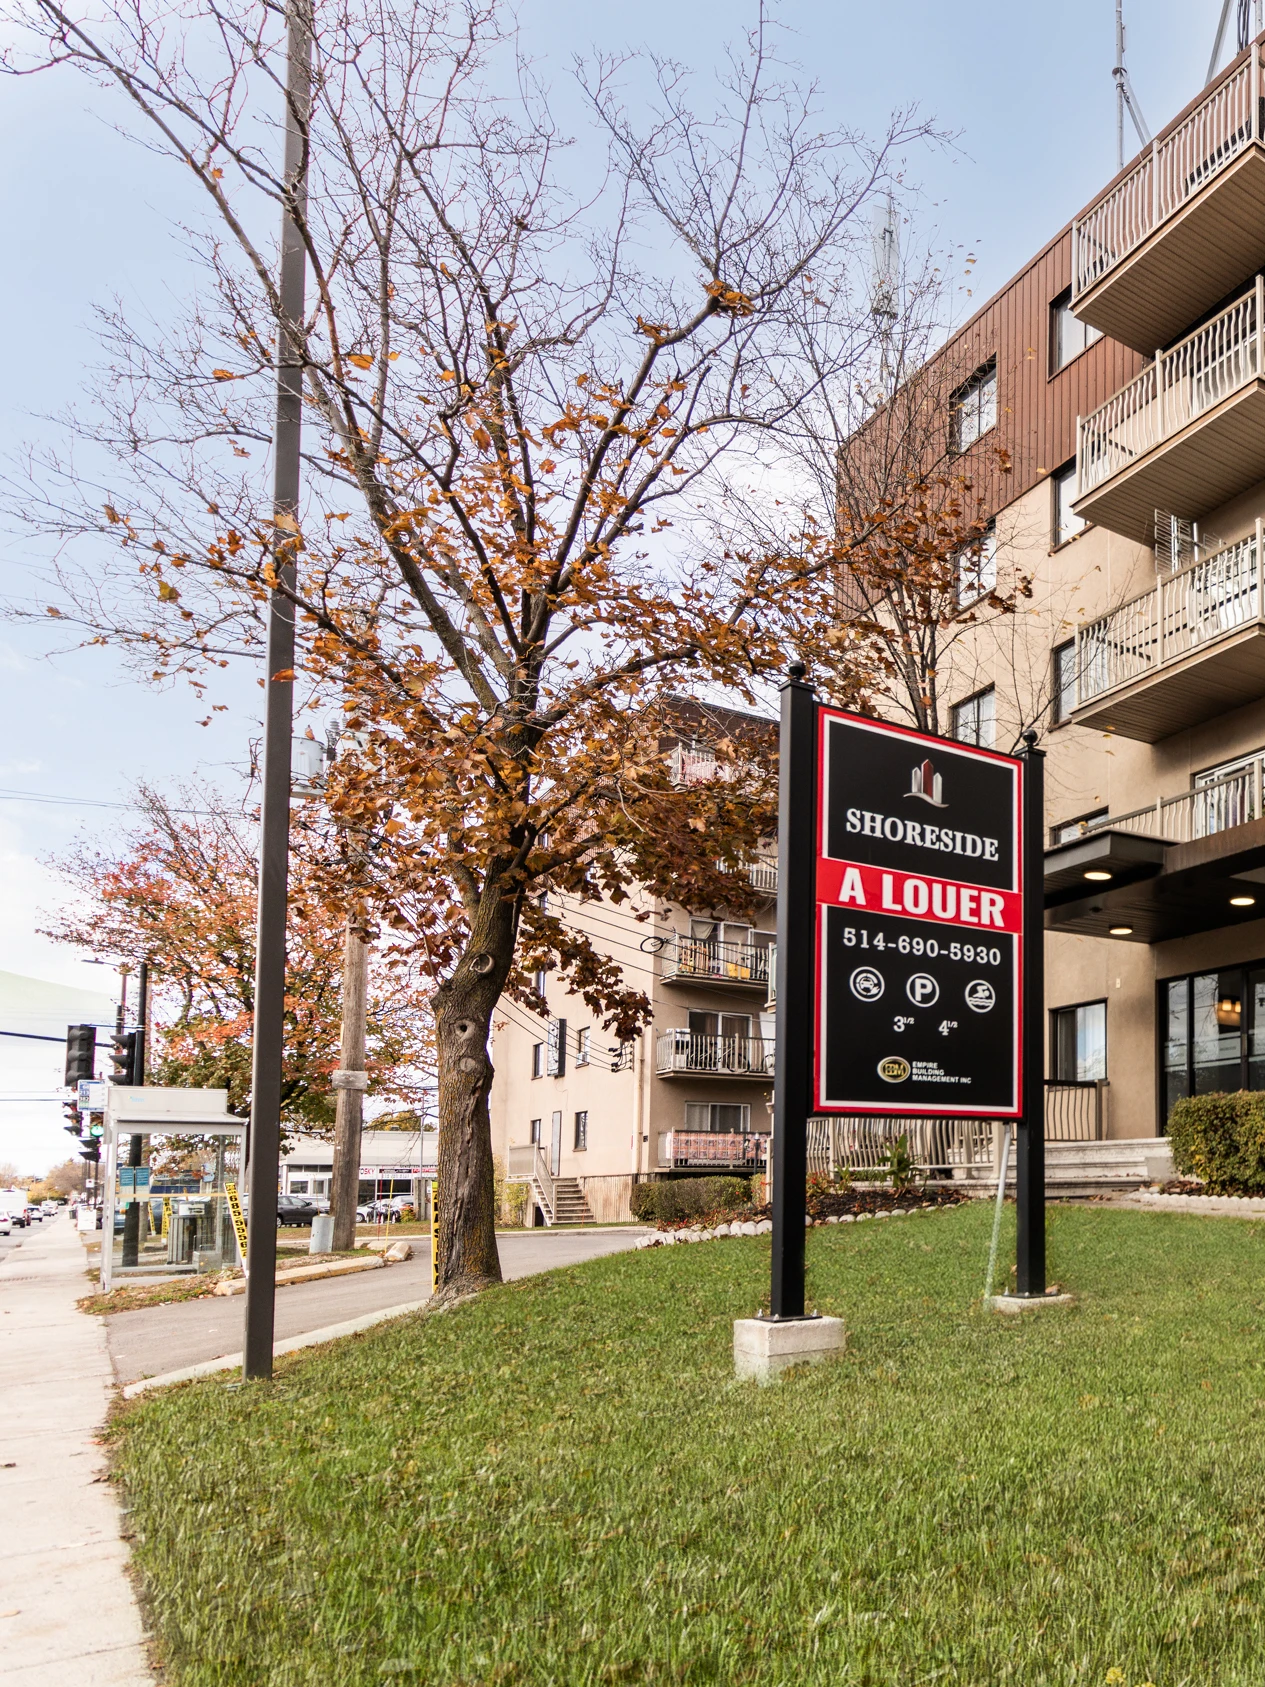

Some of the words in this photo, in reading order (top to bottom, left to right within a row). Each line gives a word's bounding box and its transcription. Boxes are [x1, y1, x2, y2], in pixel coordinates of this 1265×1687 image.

[846, 808, 999, 861] SHORESIDE
[838, 866, 866, 905] A
[882, 873, 1005, 927] LOUER
[843, 927, 1001, 965] 514-690-5930
[912, 1061, 938, 1069] EMPIRE
[912, 1068, 945, 1076] BUILDING
[912, 1074, 959, 1083] MANAGEMENT
